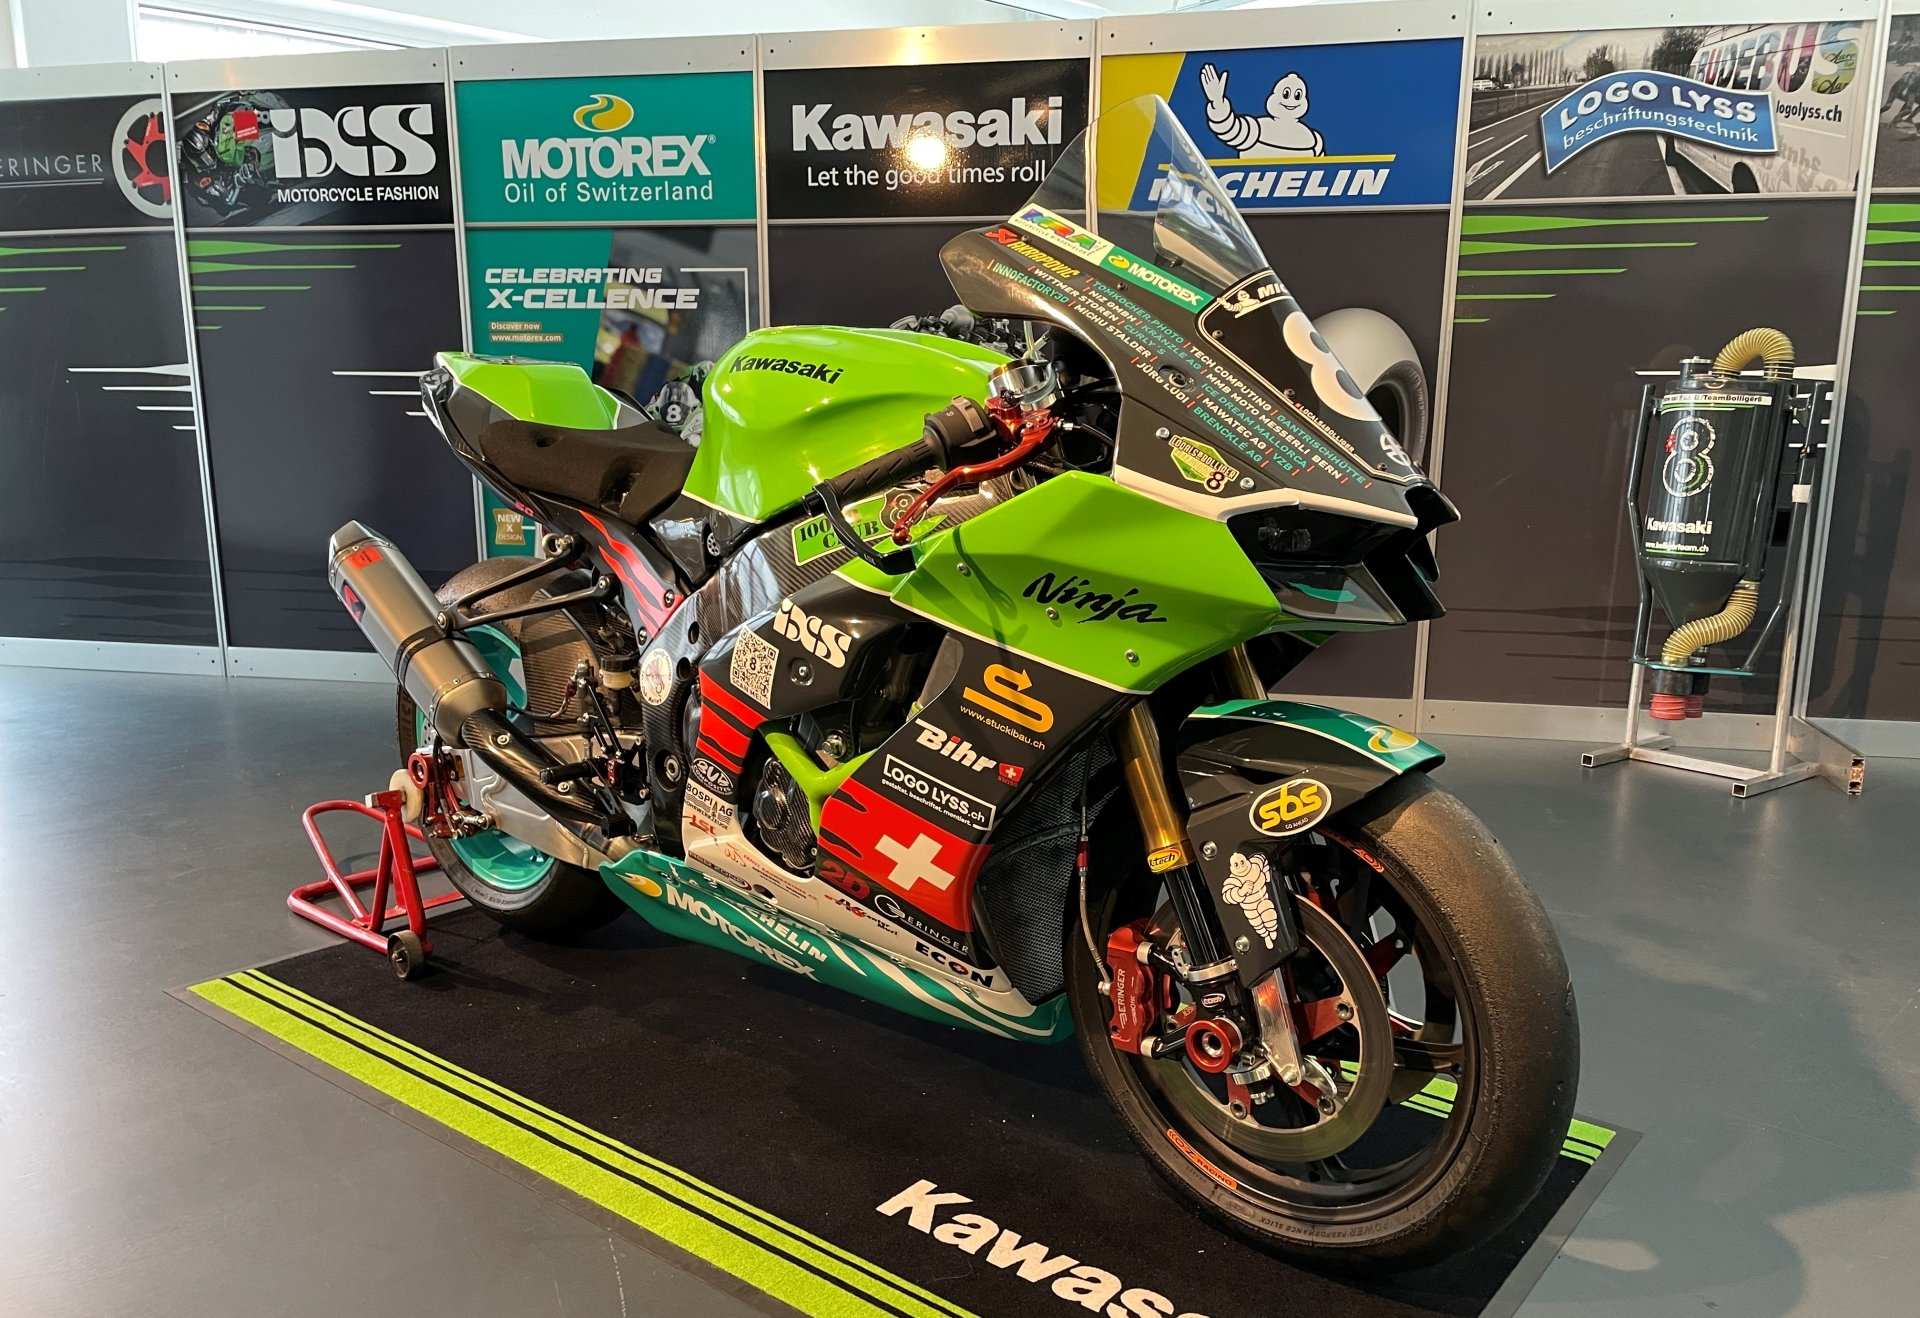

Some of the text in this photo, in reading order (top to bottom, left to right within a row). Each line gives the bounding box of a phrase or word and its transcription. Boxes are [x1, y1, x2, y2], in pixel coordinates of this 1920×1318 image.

[792, 96, 1062, 151] Kawasaki
[1560, 80, 1758, 130] LOGO LYSS
[1776, 100, 1842, 122] logolyss.ch
[1563, 106, 1758, 150] beschriftungstechnik
[277, 185, 439, 203] MOTORCYCLE FASHION
[505, 180, 713, 203] Oil of Switzerland
[808, 160, 1046, 190] Let the good times roll
[485, 268, 662, 283] CELEBRATING
[1035, 269, 1080, 298] WITTMER
[1079, 295, 1119, 322] STOREN
[1128, 263, 1203, 306] MOTOREX
[487, 288, 700, 309] X-CELLENCE
[993, 263, 1152, 358] INNOFACTORY3D MICHU STALDER
[491, 322, 519, 330] Discover
[1093, 280, 1184, 344] TOMKOCHER.PHOTO
[1189, 346, 1217, 368] TECH
[1214, 366, 1272, 411] COMPUTING
[729, 355, 844, 385] Kawasaki
[1089, 290, 1342, 480] NIZ GMBH KRÄNZLE AG MMB MOTO MESSERLI BERN
[666, 404, 681, 422] 8
[1194, 407, 1249, 451] BRENCKLÉ
[1246, 450, 1263, 462] AG
[1202, 384, 1307, 469] ICE DREAM MALLORCA
[1202, 398, 1294, 471] MAWATEC AG VZB
[1206, 471, 1225, 490] 8
[497, 514, 522, 522] NEW
[506, 524, 514, 532] X
[1647, 517, 1712, 534] Kawasaki
[1022, 572, 1168, 623] Ninja
[915, 718, 997, 772] Bihr
[960, 705, 1046, 751] www.stuckibau.ch
[687, 783, 733, 817] BOSPI AG
[883, 765, 985, 823] LOGO LYSS.ch
[1259, 785, 1322, 830] sbs
[820, 860, 870, 899] 2D
[666, 883, 822, 983] MOTOREX
[915, 941, 993, 988] ECON
[1118, 969, 1127, 1029] BERINGER
[1197, 1159, 1232, 1186] RACING
[1259, 1216, 1284, 1231] SLICK
[876, 1179, 1213, 1318] Kawas
